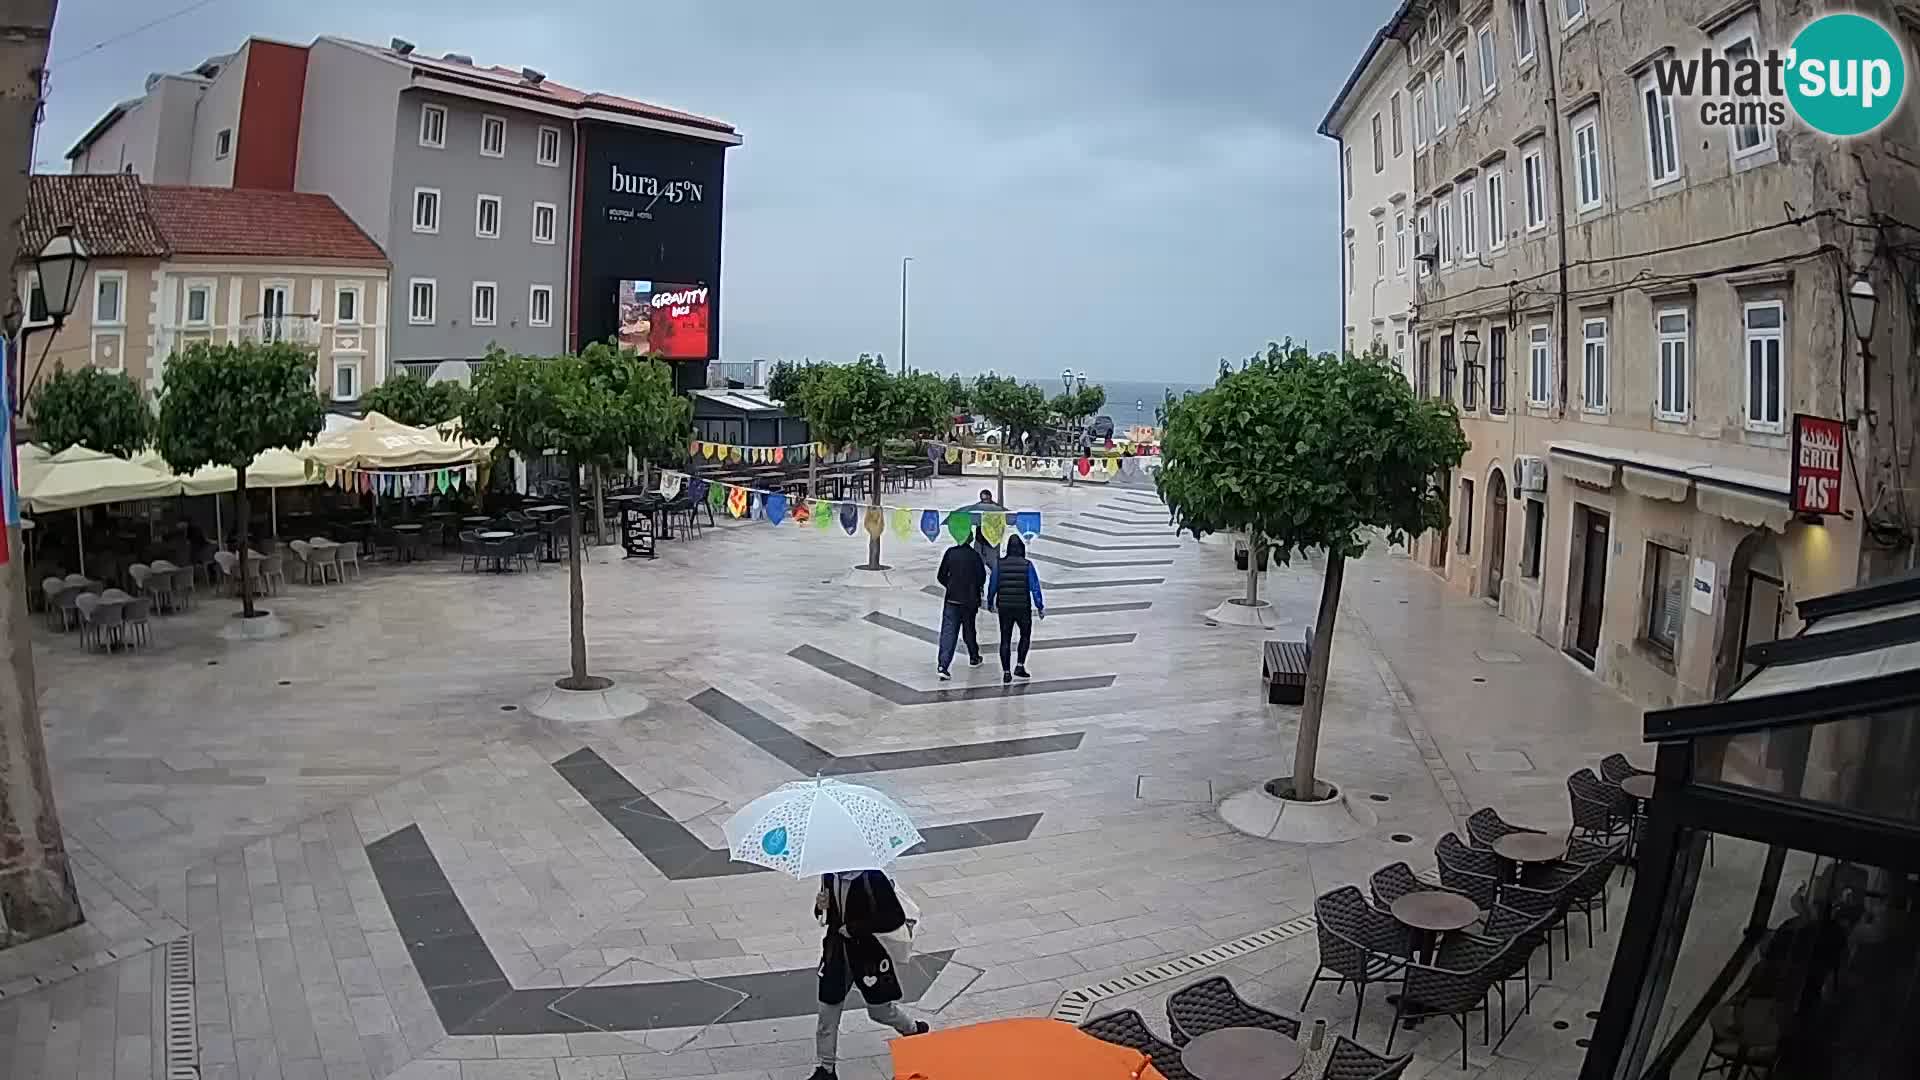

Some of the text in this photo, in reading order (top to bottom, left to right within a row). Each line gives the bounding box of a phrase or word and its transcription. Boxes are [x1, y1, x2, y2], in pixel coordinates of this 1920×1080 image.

[612, 165, 658, 197] bura
[651, 287, 708, 308] GRAVITY
[1800, 447, 1839, 471] GRILL
